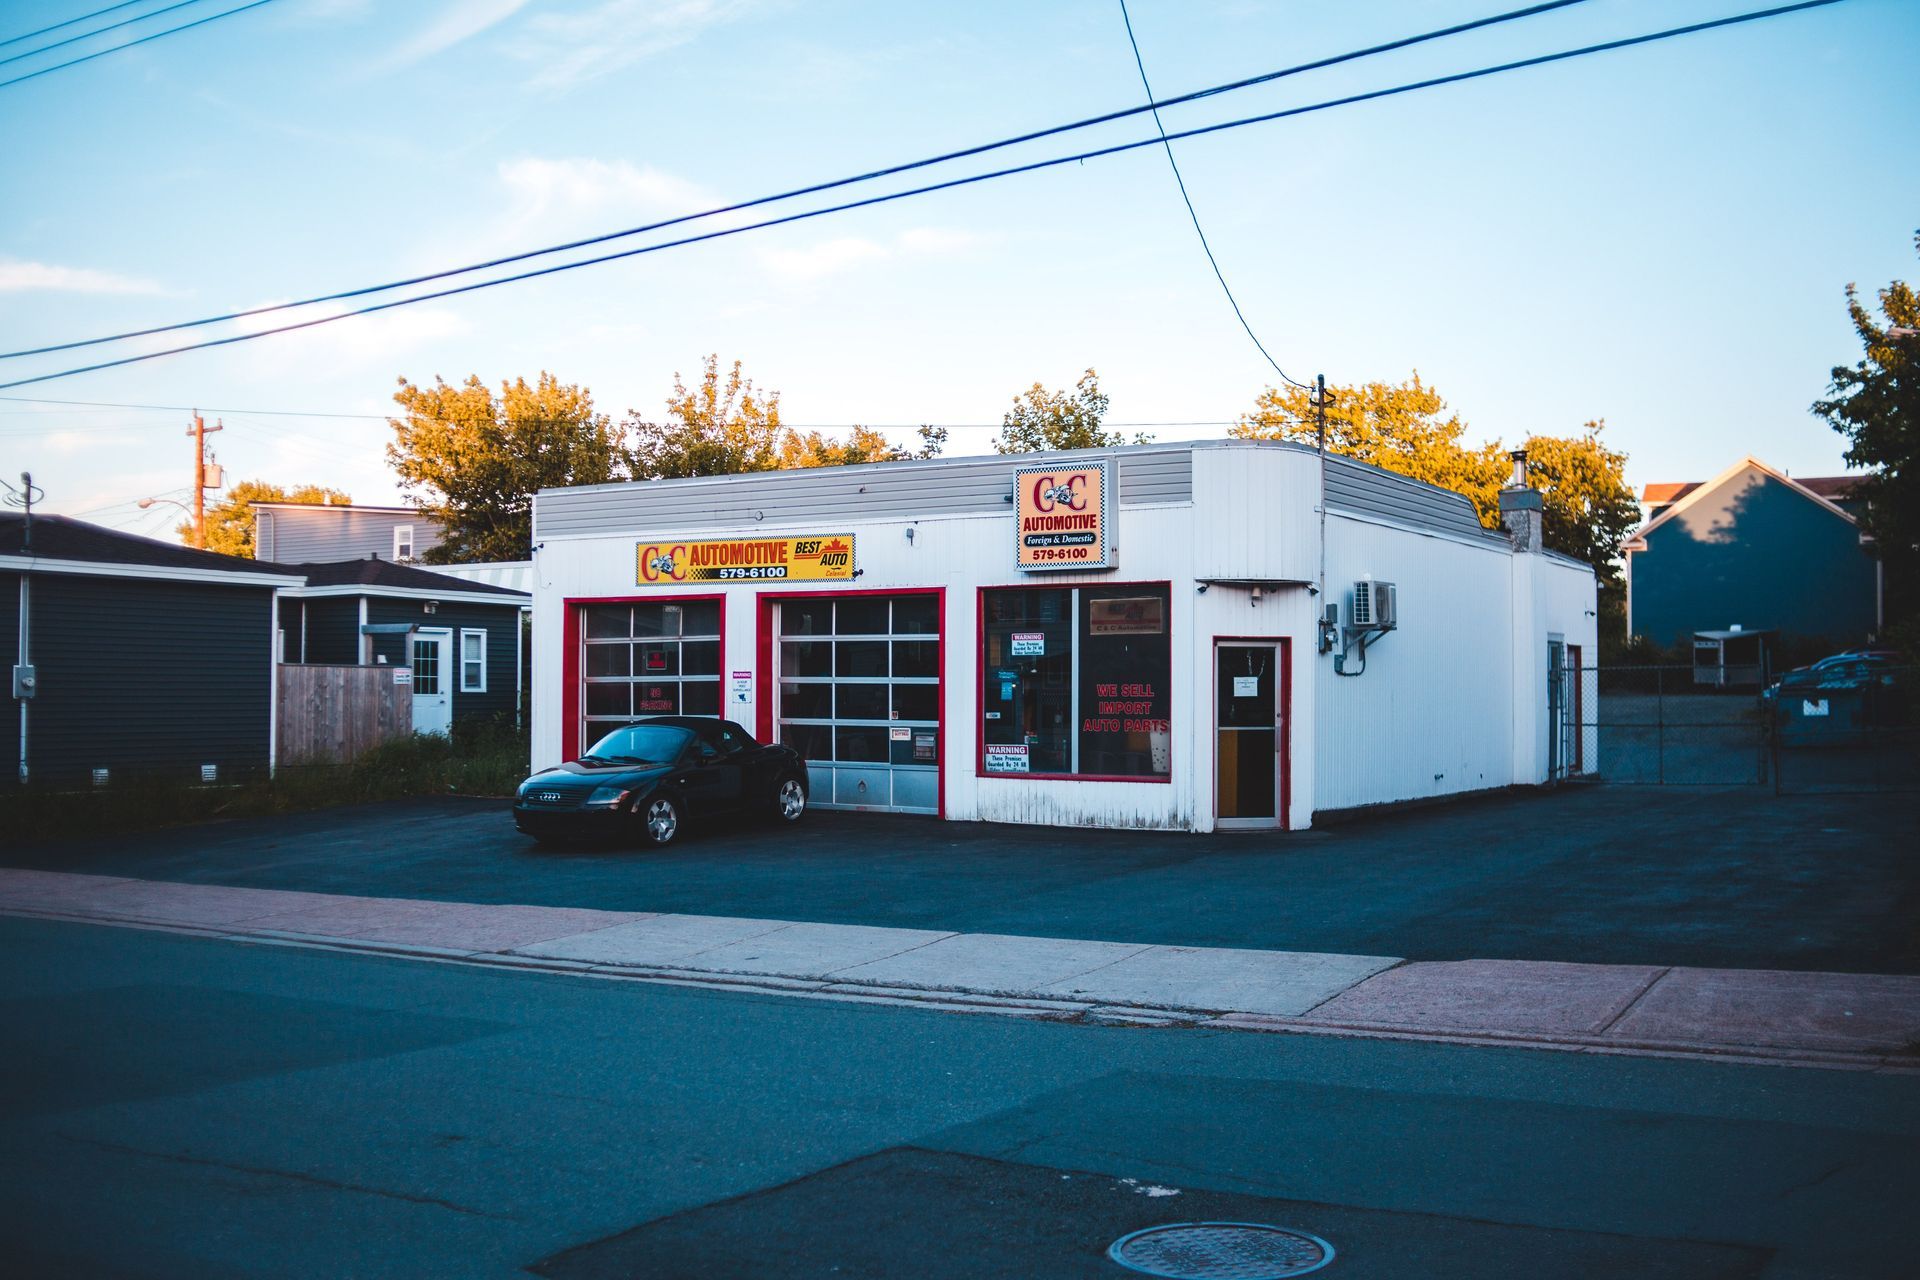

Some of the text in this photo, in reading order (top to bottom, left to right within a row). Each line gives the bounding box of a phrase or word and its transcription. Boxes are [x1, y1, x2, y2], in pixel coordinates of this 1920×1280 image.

[1023, 514, 1097, 532] AUTOMOTIVE
[1027, 534, 1094, 546] Foreign & Domestic
[690, 542, 788, 566] AUTOMOTIVE
[795, 541, 822, 554] BEST
[1032, 548, 1088, 560] 579-6100
[820, 553, 848, 566] AUTO
[719, 567, 786, 579] 579-6100
[1097, 684, 1154, 697] WE SELL
[1099, 701, 1152, 714] IMPORT
[1083, 719, 1169, 732] AUTO PARTS
[988, 746, 1025, 754] WARNING
